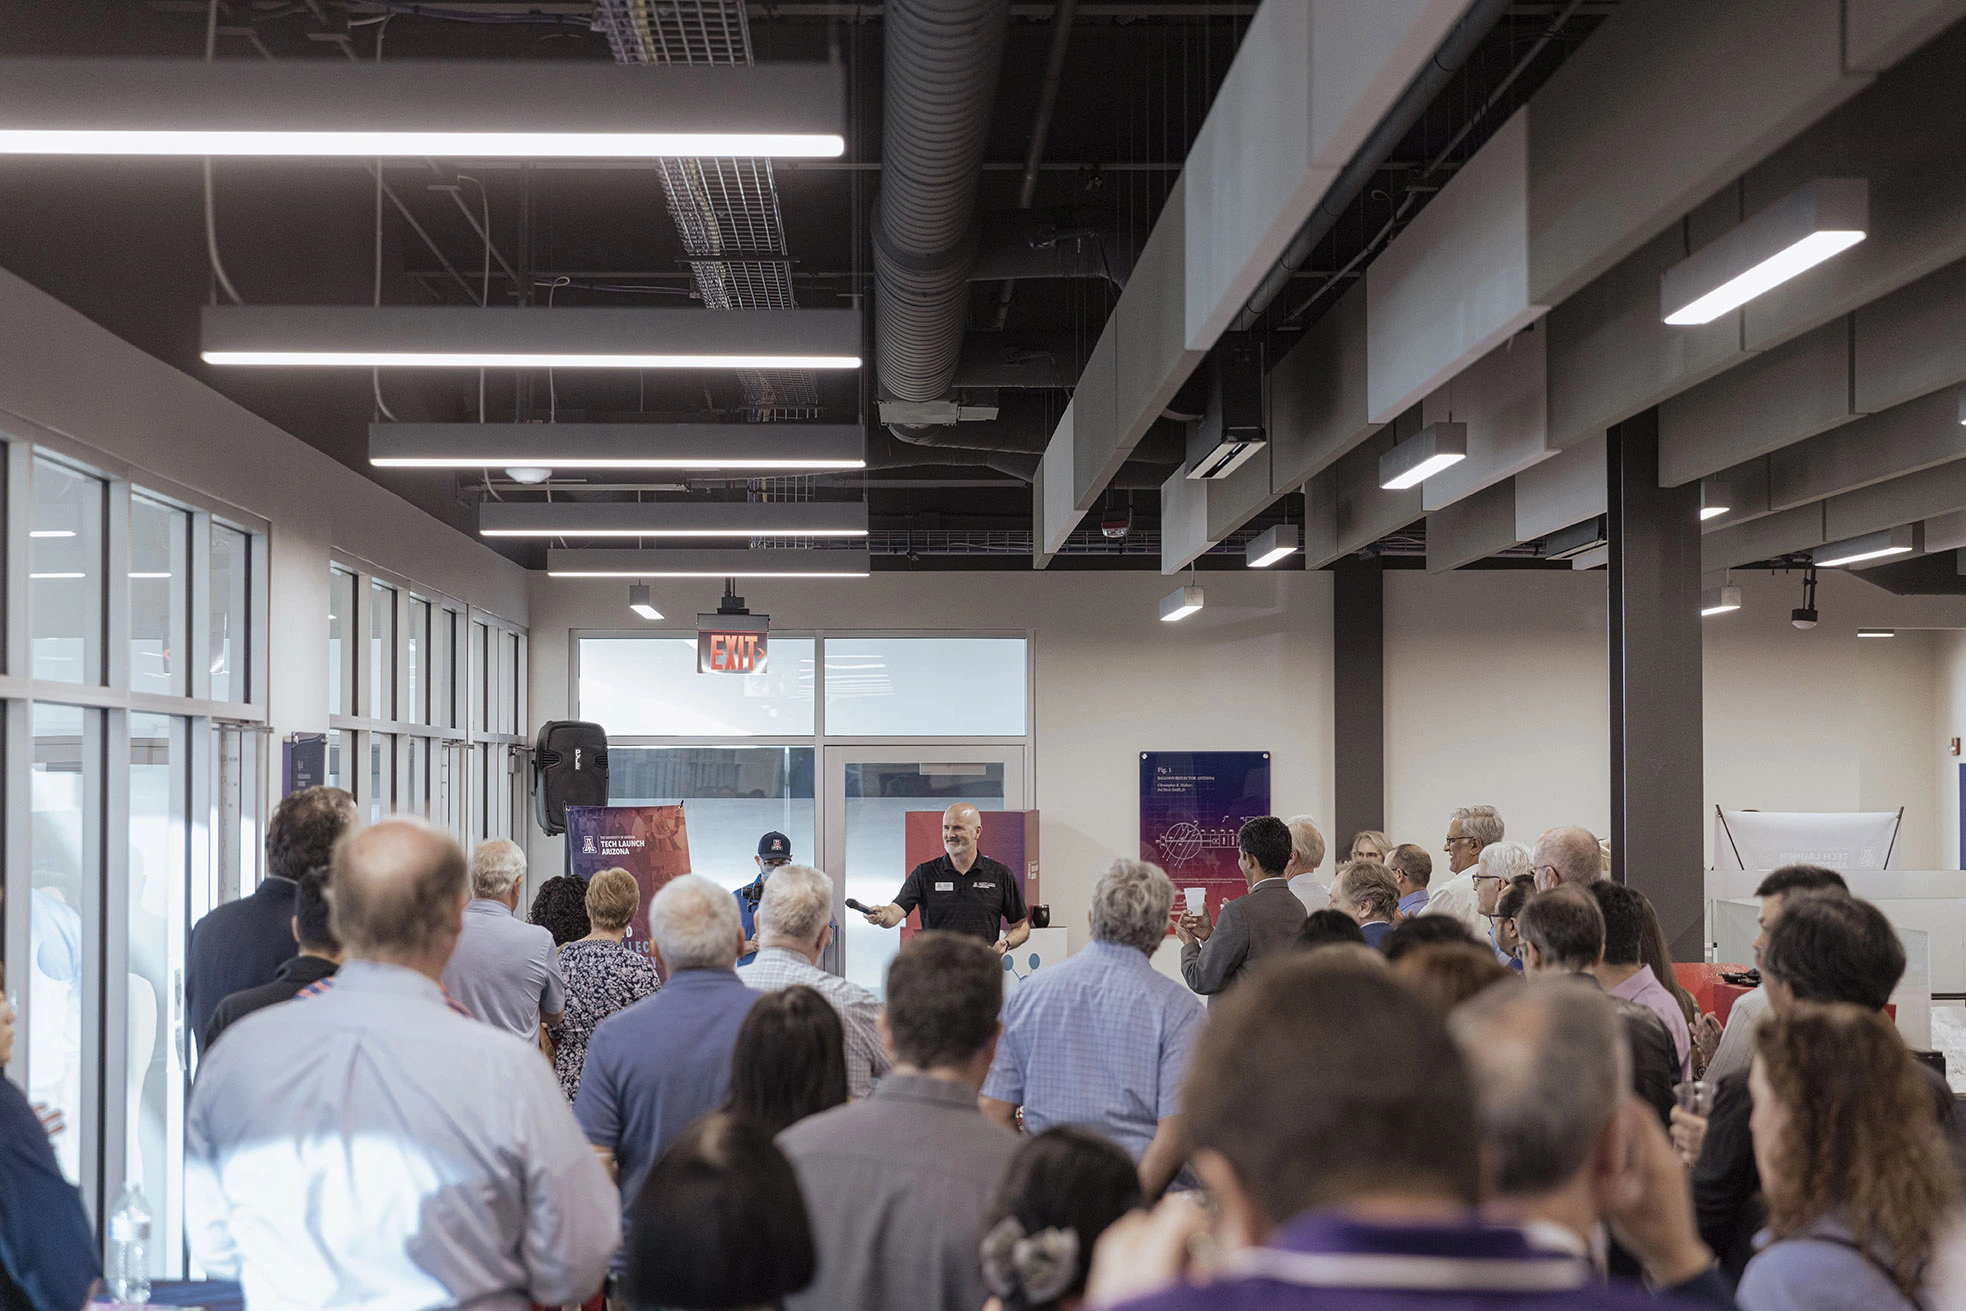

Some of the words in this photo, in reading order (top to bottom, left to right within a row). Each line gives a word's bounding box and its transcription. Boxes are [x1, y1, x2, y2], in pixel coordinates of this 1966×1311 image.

[710, 634, 758, 671] EXIT
[600, 840, 618, 848] TECH
[618, 840, 645, 848] LAUNCH
